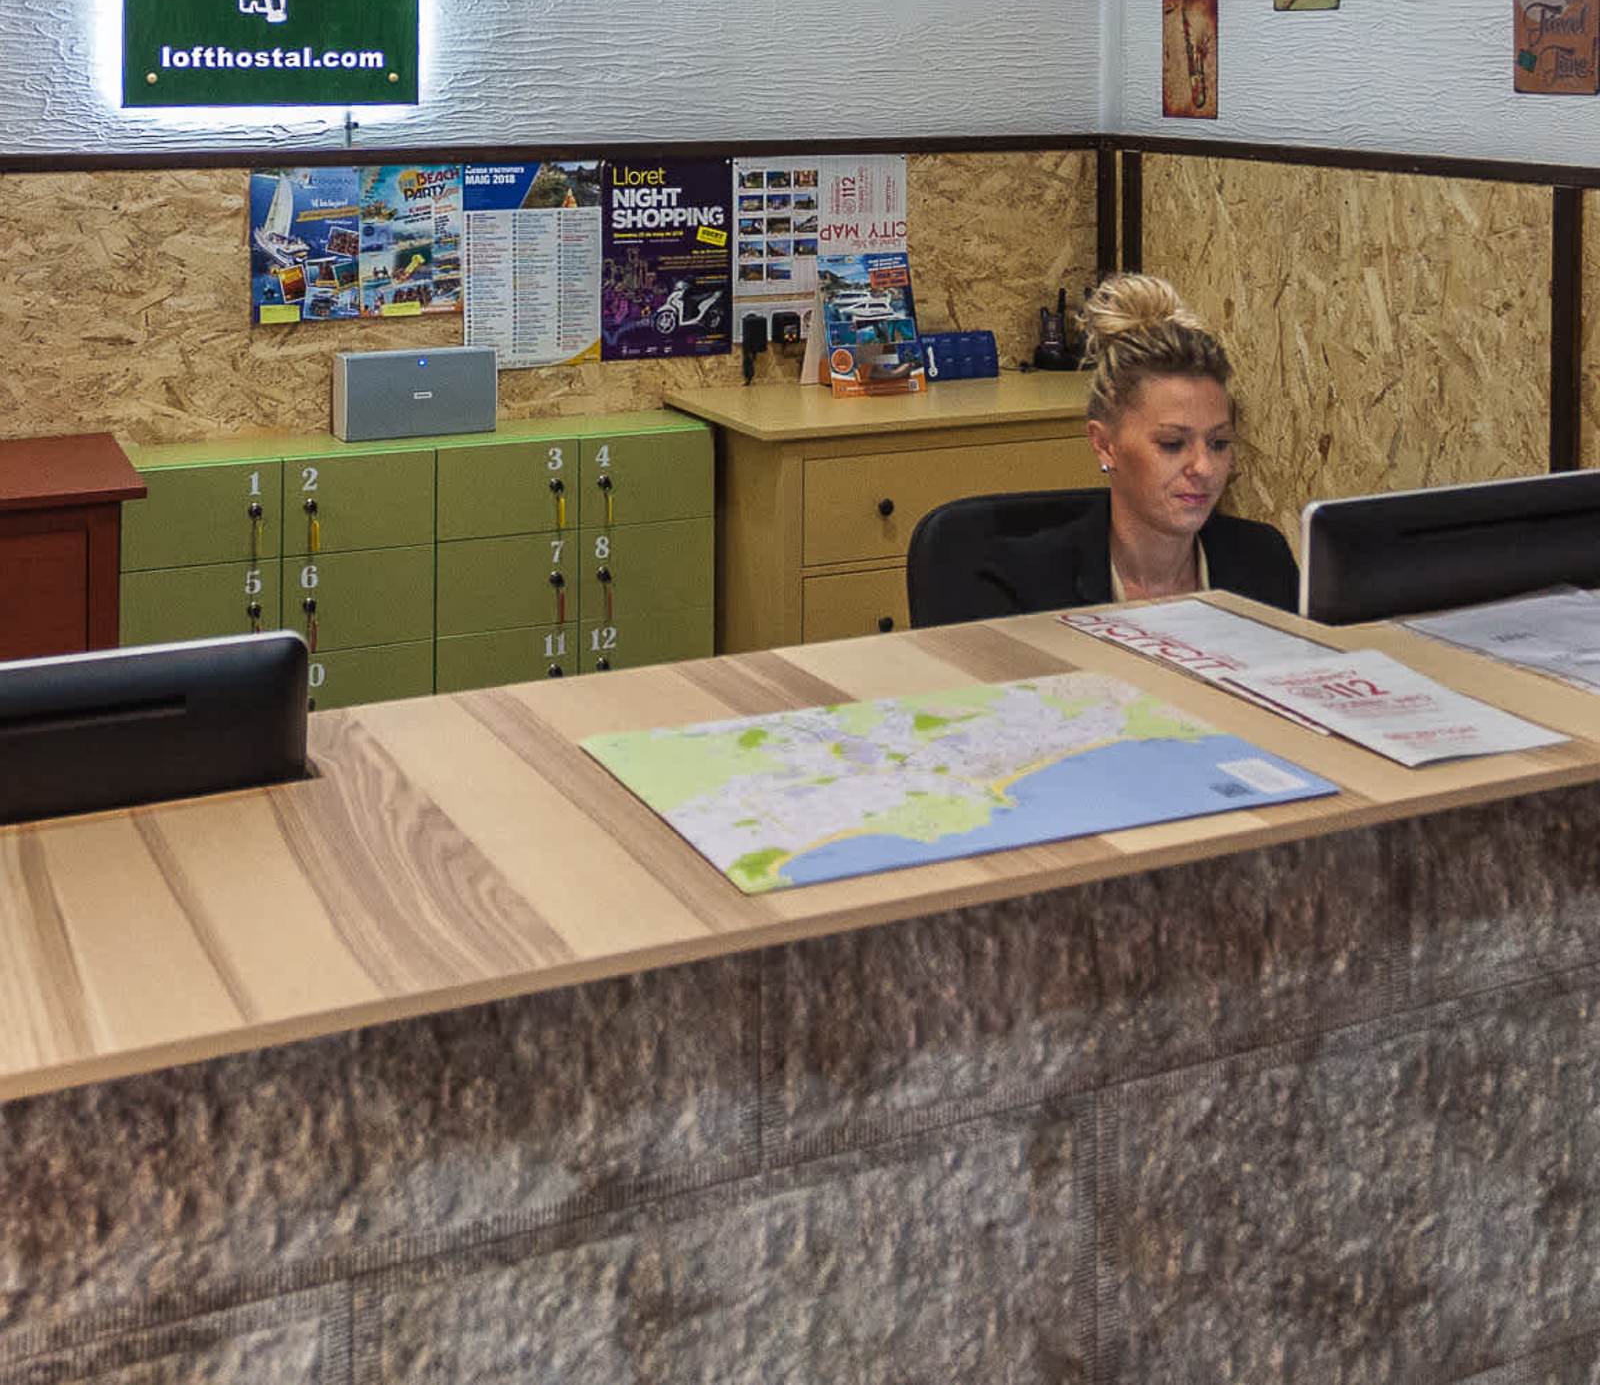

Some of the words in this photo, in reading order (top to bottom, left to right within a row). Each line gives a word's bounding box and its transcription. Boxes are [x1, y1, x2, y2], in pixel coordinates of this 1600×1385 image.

[161, 46, 385, 68] lofthostal.com
[416, 168, 460, 186] BEACH
[465, 175, 490, 185] MAIG
[493, 174, 515, 184] 2018
[612, 166, 666, 185] Lloret
[842, 177, 856, 197] 112
[403, 183, 446, 202] PARTY
[612, 188, 682, 208] NIGHT
[612, 206, 724, 229] SHOPPING
[820, 222, 859, 241] MAP
[869, 221, 907, 238] CITY
[548, 447, 562, 470] 3
[595, 444, 611, 467] 4
[248, 472, 261, 496] 1
[302, 467, 318, 491] 2
[551, 541, 564, 565] 7
[595, 535, 609, 559] 8
[245, 570, 261, 595] 5
[301, 566, 318, 589] 6
[544, 633, 566, 656] 11
[591, 627, 617, 651] 12
[308, 663, 325, 687] 0
[1322, 679, 1391, 699] 112
